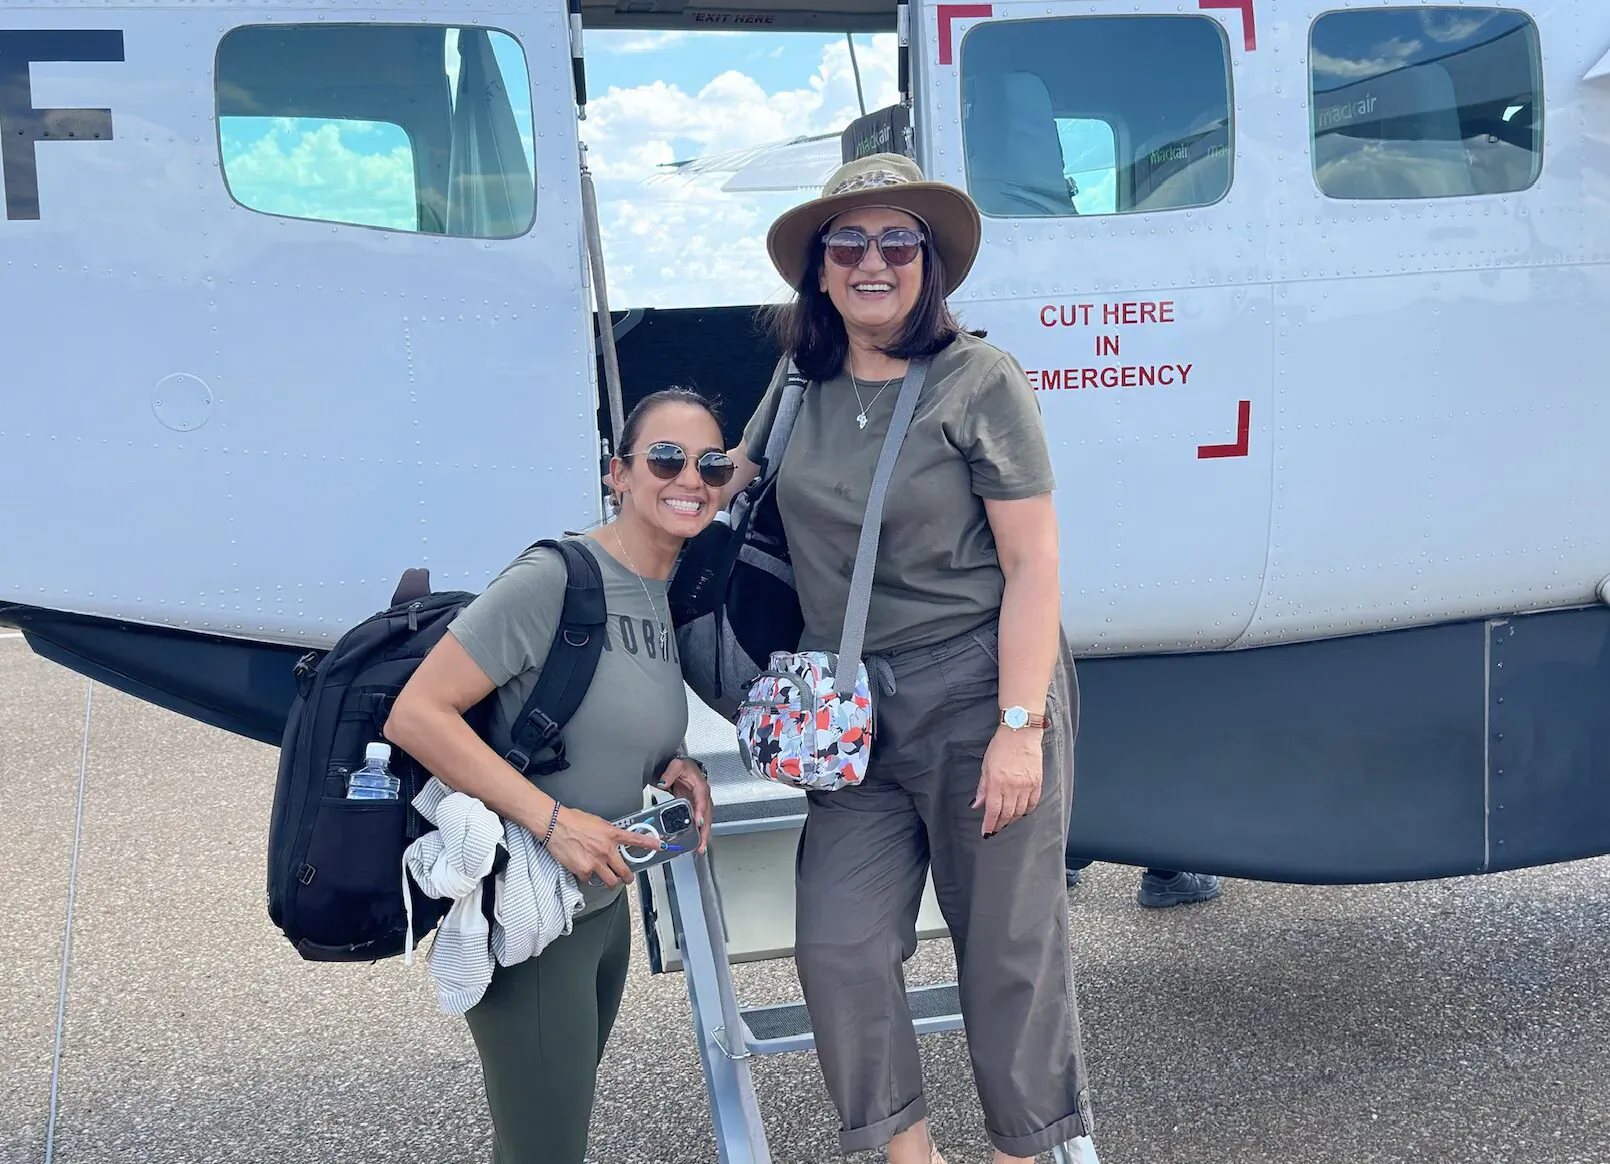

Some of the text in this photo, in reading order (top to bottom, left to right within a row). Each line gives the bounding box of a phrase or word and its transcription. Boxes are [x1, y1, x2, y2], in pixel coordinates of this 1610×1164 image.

[695, 12, 775, 24] EXIT HERE
[0, 29, 125, 220] F
[1040, 301, 1175, 327] CUT HERE
[1096, 335, 1119, 356] IN
[1025, 364, 1193, 391] EMERGENCY
